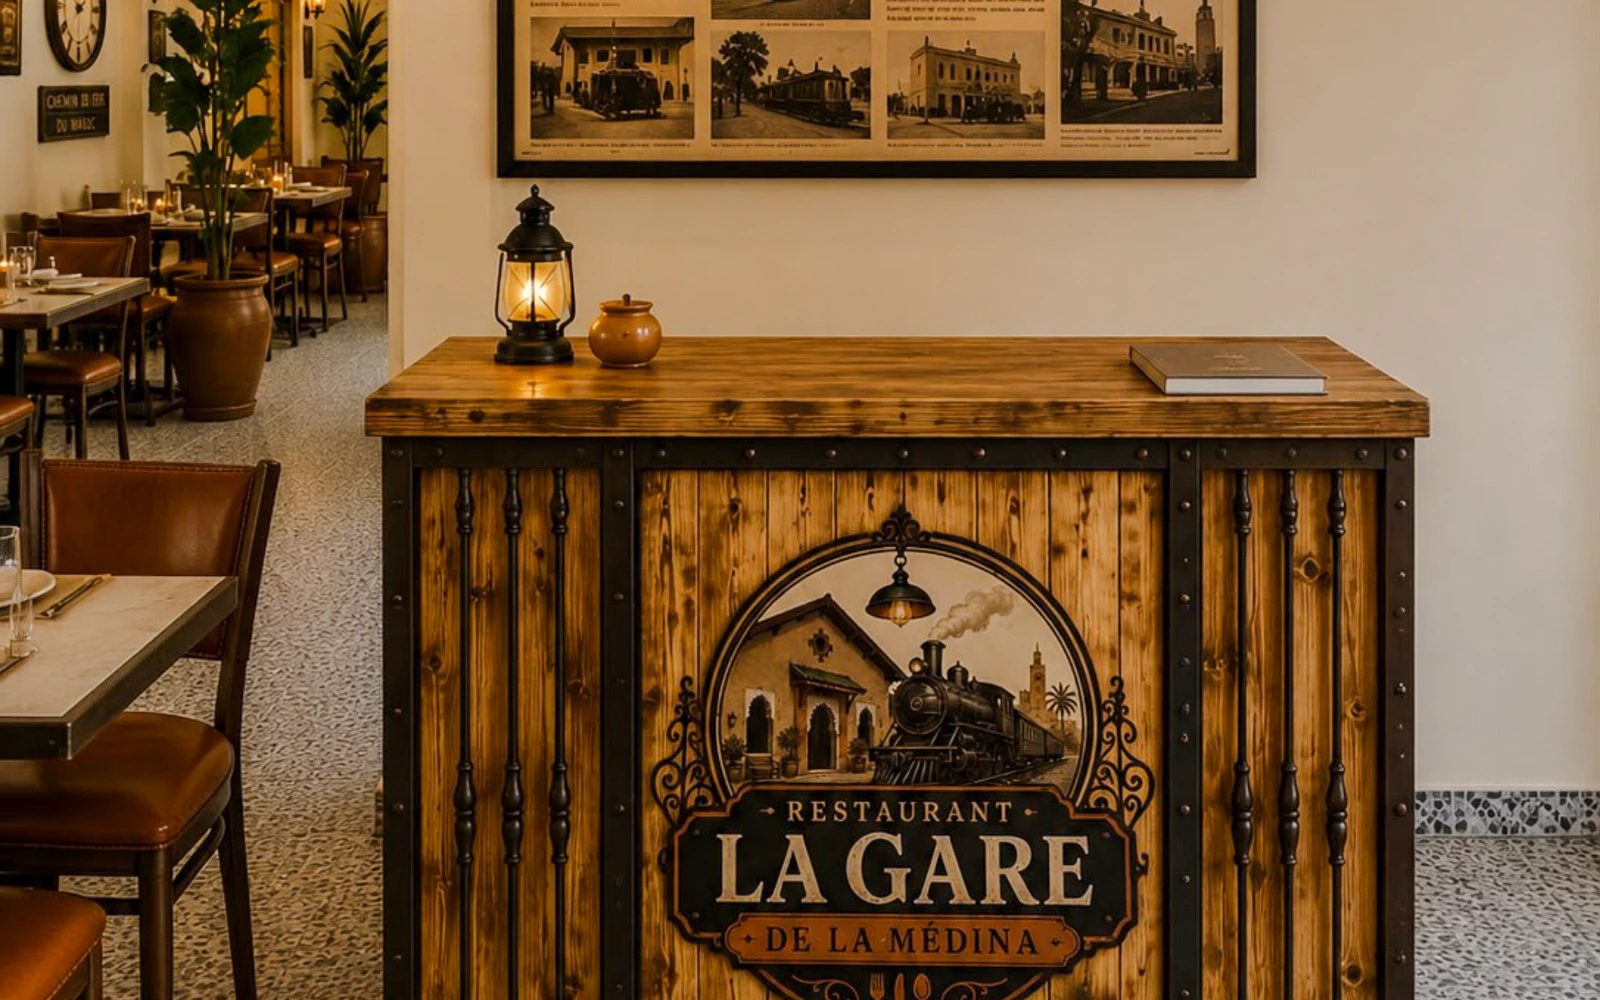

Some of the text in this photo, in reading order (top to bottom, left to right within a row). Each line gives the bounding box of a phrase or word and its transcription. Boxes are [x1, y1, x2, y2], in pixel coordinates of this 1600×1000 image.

[788, 800, 1012, 823] RESTAURANT
[716, 832, 1093, 906] LA GARE
[766, 922, 1038, 955] DE LA MÉDINA
